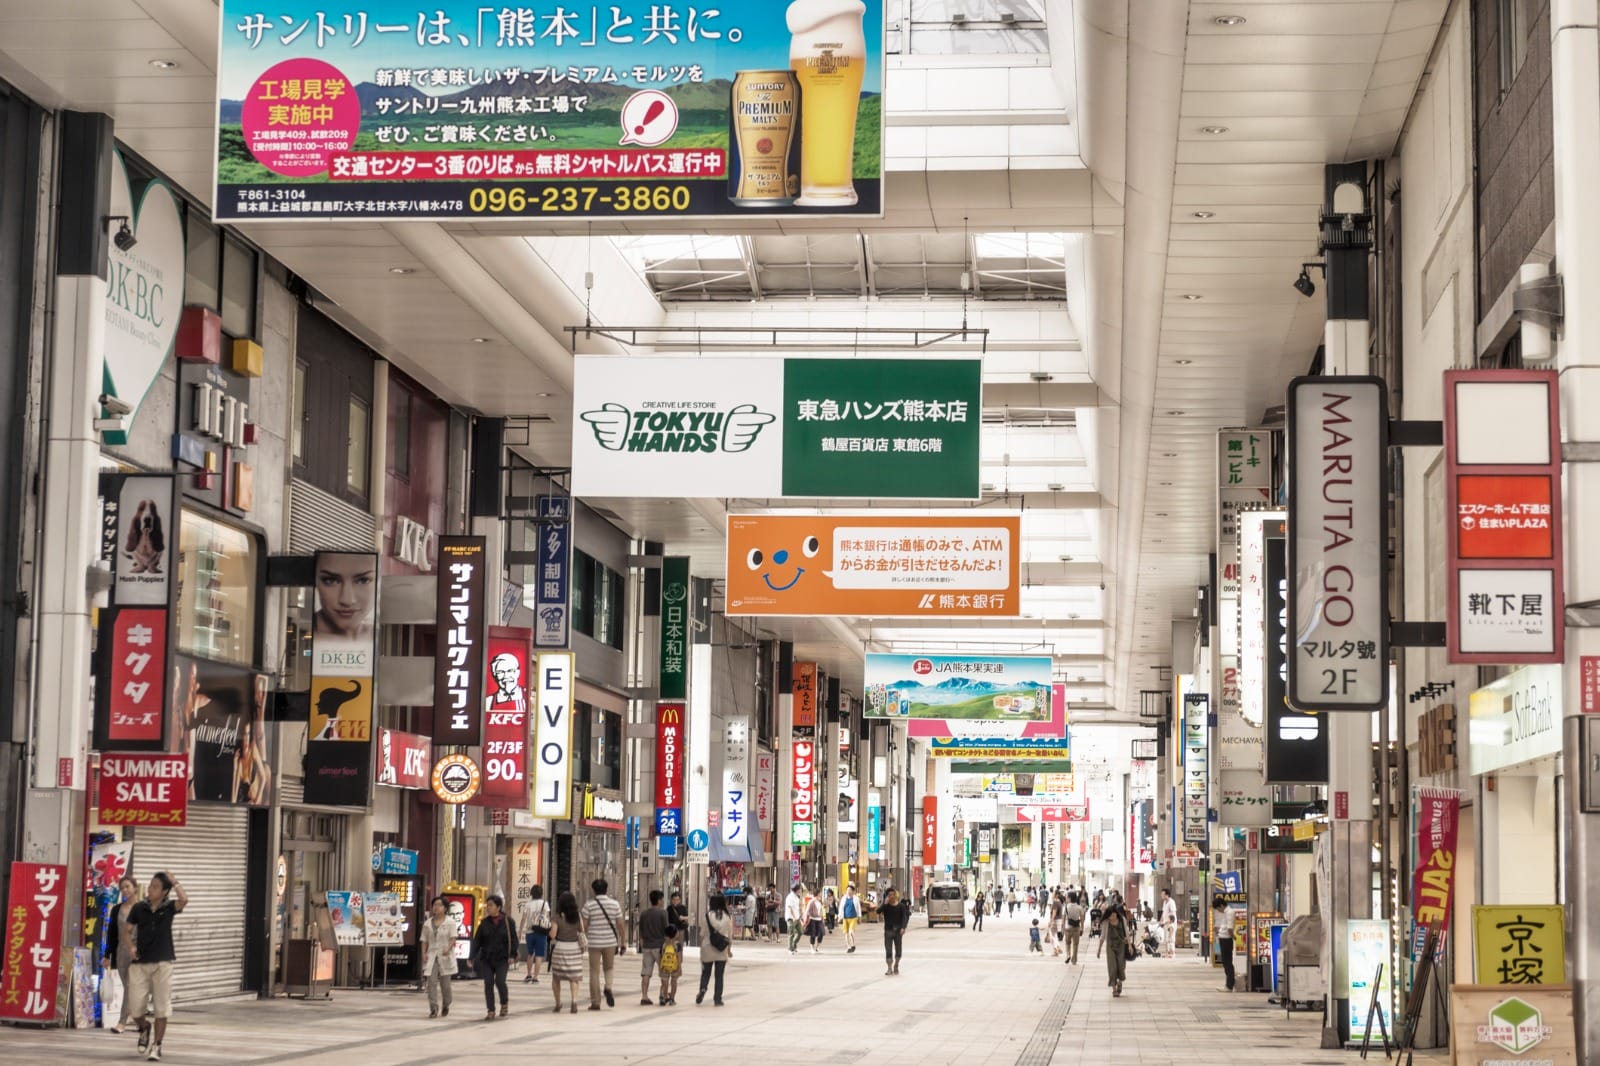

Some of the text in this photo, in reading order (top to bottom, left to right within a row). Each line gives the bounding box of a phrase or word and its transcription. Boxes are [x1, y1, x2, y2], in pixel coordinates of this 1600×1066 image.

[237, 5, 743, 49] サントリーは、「熊本」と共に。
[375, 65, 703, 86] 新鮮で美味しいザ・プレミアム・モルツを
[258, 79, 346, 101] 工場見学
[746, 83, 785, 91] SUNTORY
[267, 104, 334, 126] 実施中
[375, 96, 588, 115] サントリー九州熊本工場で
[739, 101, 791, 115] PREMIUM
[752, 116, 778, 124] MALTS
[375, 125, 556, 144] ぜひ、ご賞味ください。
[237, 190, 305, 201] 〒861-3104
[469, 186, 691, 211] 096-237-3860
[642, 401, 716, 410] CREATIVE LIFE STORE
[797, 398, 968, 423] 東急ハンズ熊本店
[632, 410, 724, 432] TOKYU
[627, 432, 718, 453] HANDS
[821, 437, 942, 453] 鶴屋百貨店 東館6階
[1227, 440, 1243, 484] 第一ビル
[1321, 392, 1355, 627] MARUTA GO
[1458, 504, 1551, 515] エスケーホーム下通店
[1478, 518, 1548, 529] 住まいPLAZA
[395, 514, 434, 573] KFC
[840, 538, 1004, 553] 熊本銀行は通帳のみで、ATM
[136, 577, 164, 586] Puppies
[939, 594, 1006, 609] 熊本銀行
[1468, 593, 1543, 616] 靴下屋
[447, 563, 474, 733] サンマルクカフェ
[665, 607, 684, 673] 日本和装
[1301, 641, 1377, 660] マルタ號
[123, 625, 153, 704] キクタ
[935, 662, 1004, 674] JA熊本果実連
[1320, 669, 1358, 695] 2F
[113, 711, 159, 725] シューズ
[489, 713, 526, 727] KFC
[487, 741, 523, 754] 2F/3F
[102, 760, 185, 778] SUMMER
[403, 749, 427, 783] KFC
[664, 726, 678, 806] McDonald's
[115, 783, 170, 803] SALE
[101, 812, 182, 827] キクタシューズ
[728, 791, 742, 840] マキノ
[23, 868, 60, 1015] サマーセール
[1496, 915, 1546, 984] 京塚
[5, 906, 28, 1005] キクタシューズ
